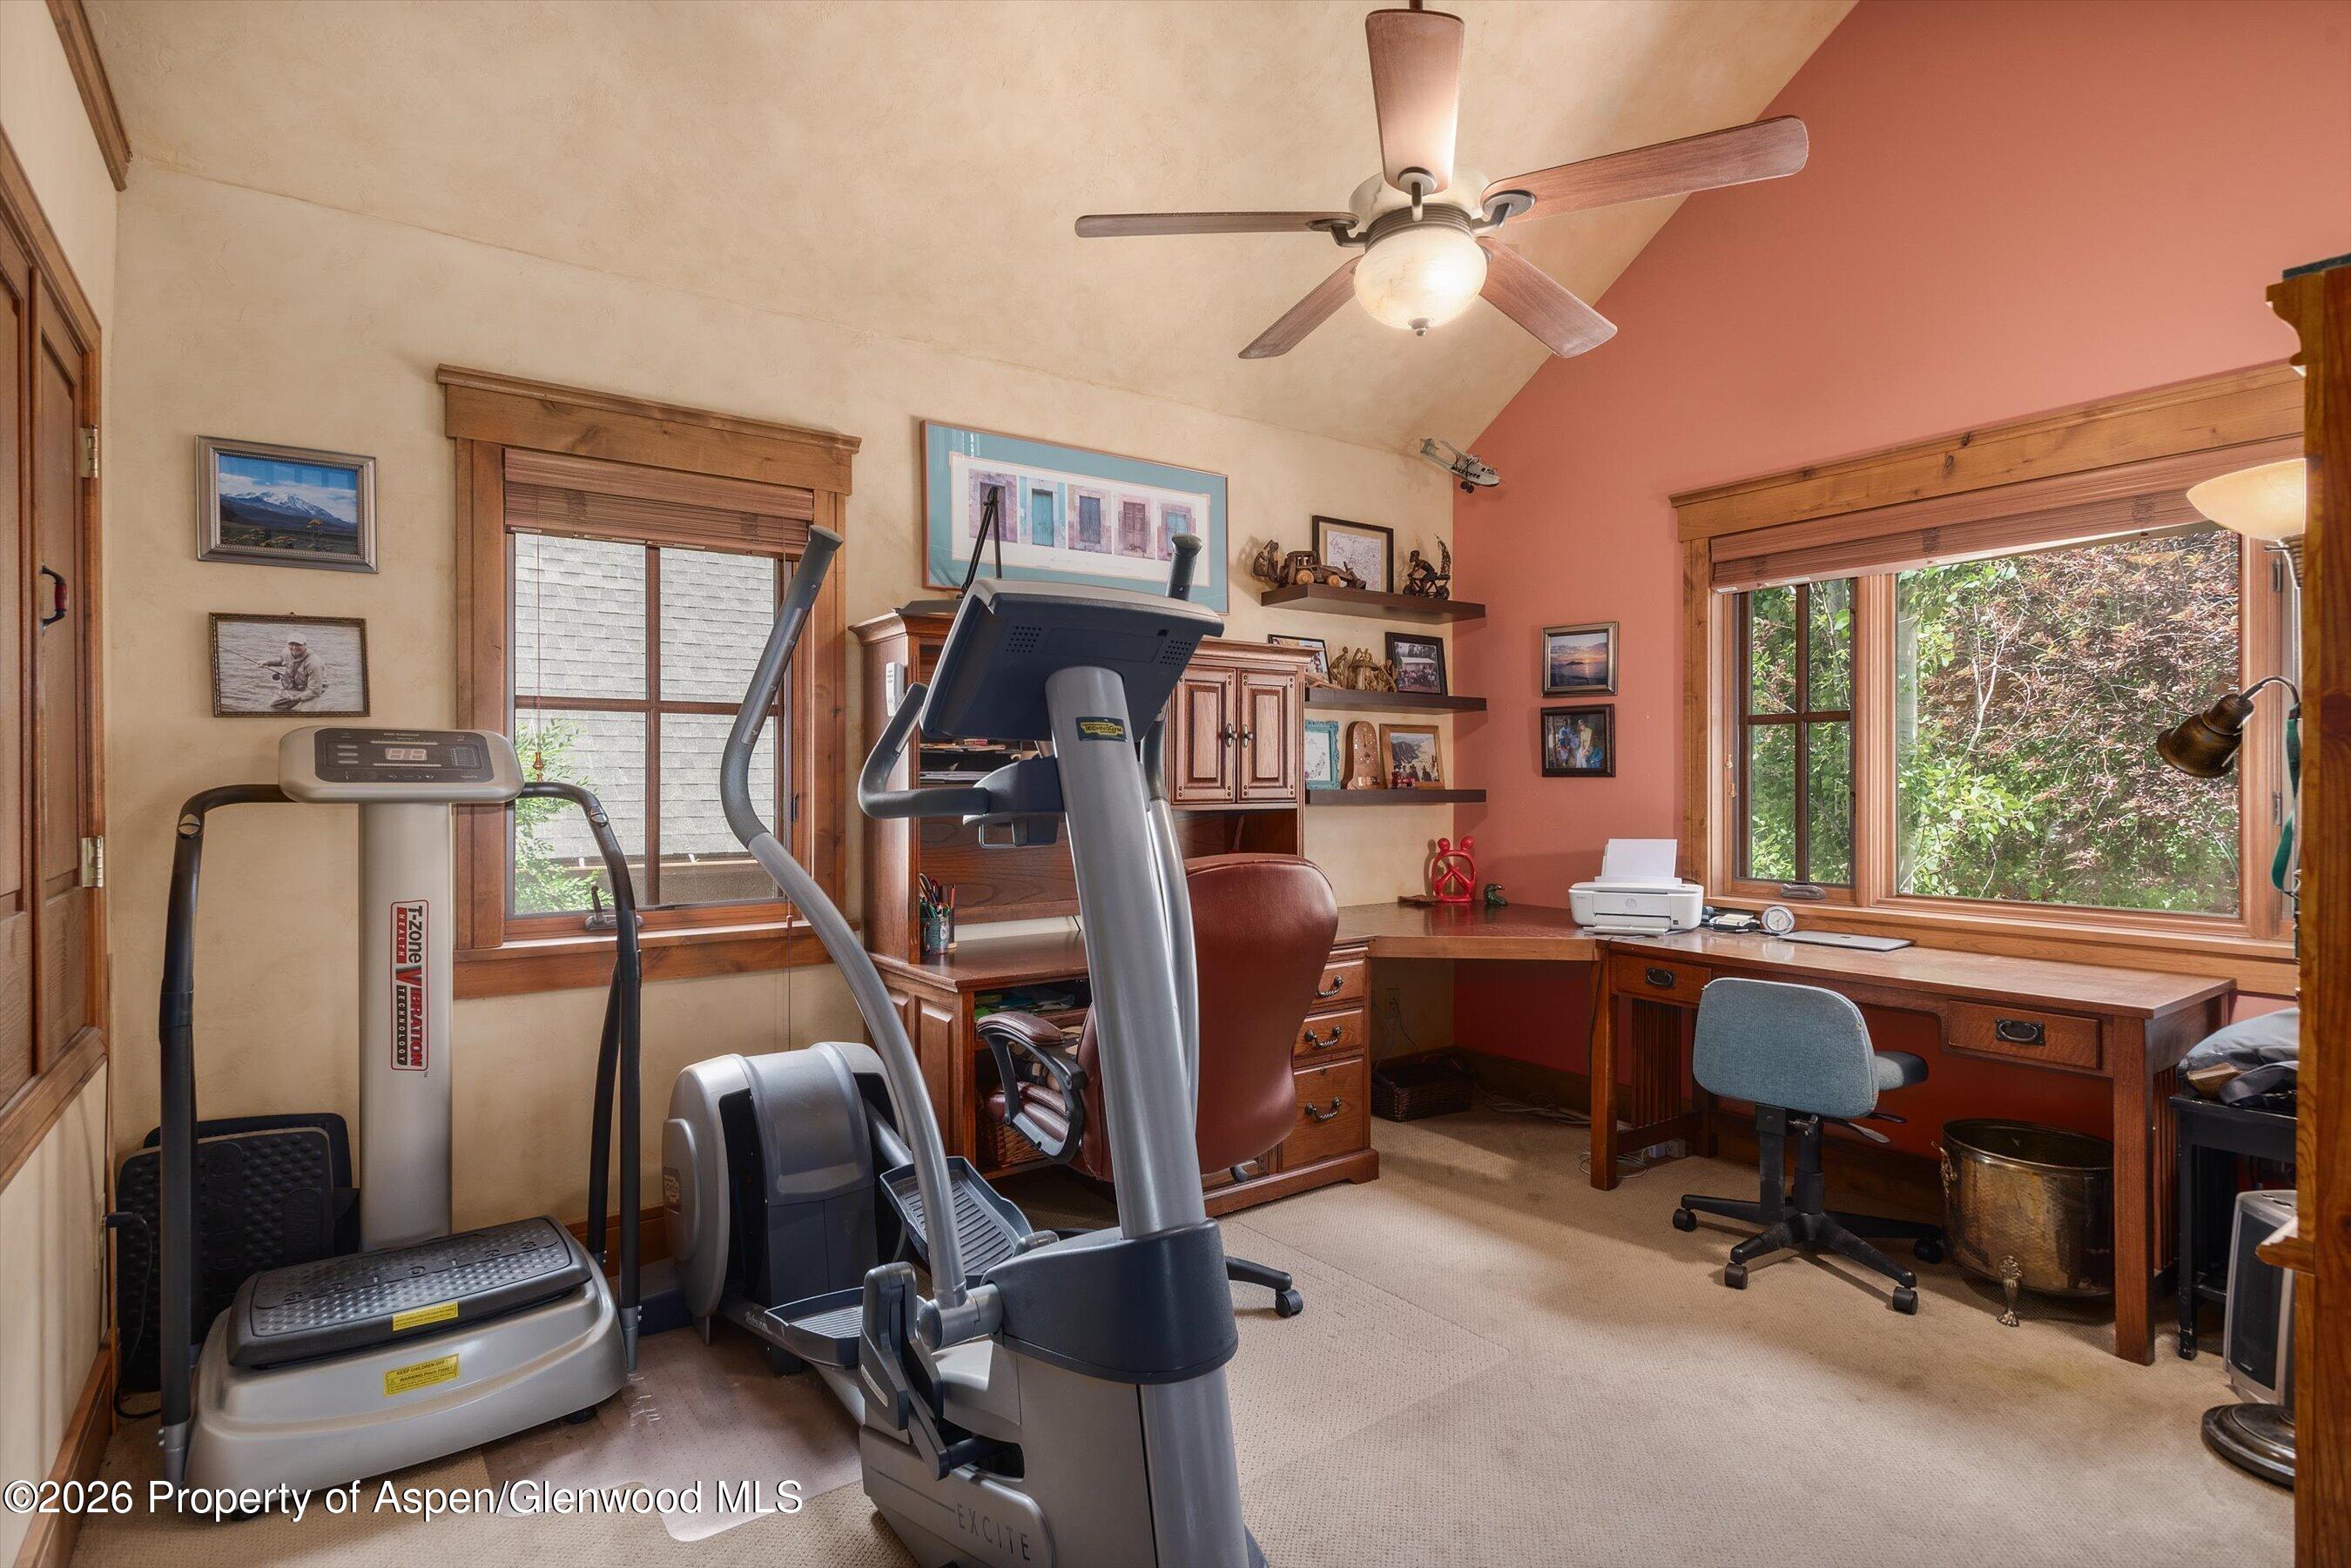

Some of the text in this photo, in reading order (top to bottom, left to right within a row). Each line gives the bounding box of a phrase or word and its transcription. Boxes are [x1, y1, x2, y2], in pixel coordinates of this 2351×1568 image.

[1081, 723, 1122, 733] TECHNOGYM
[396, 905, 422, 1067] T-zone VIBRATION
[956, 1503, 1030, 1561] EXCITE
